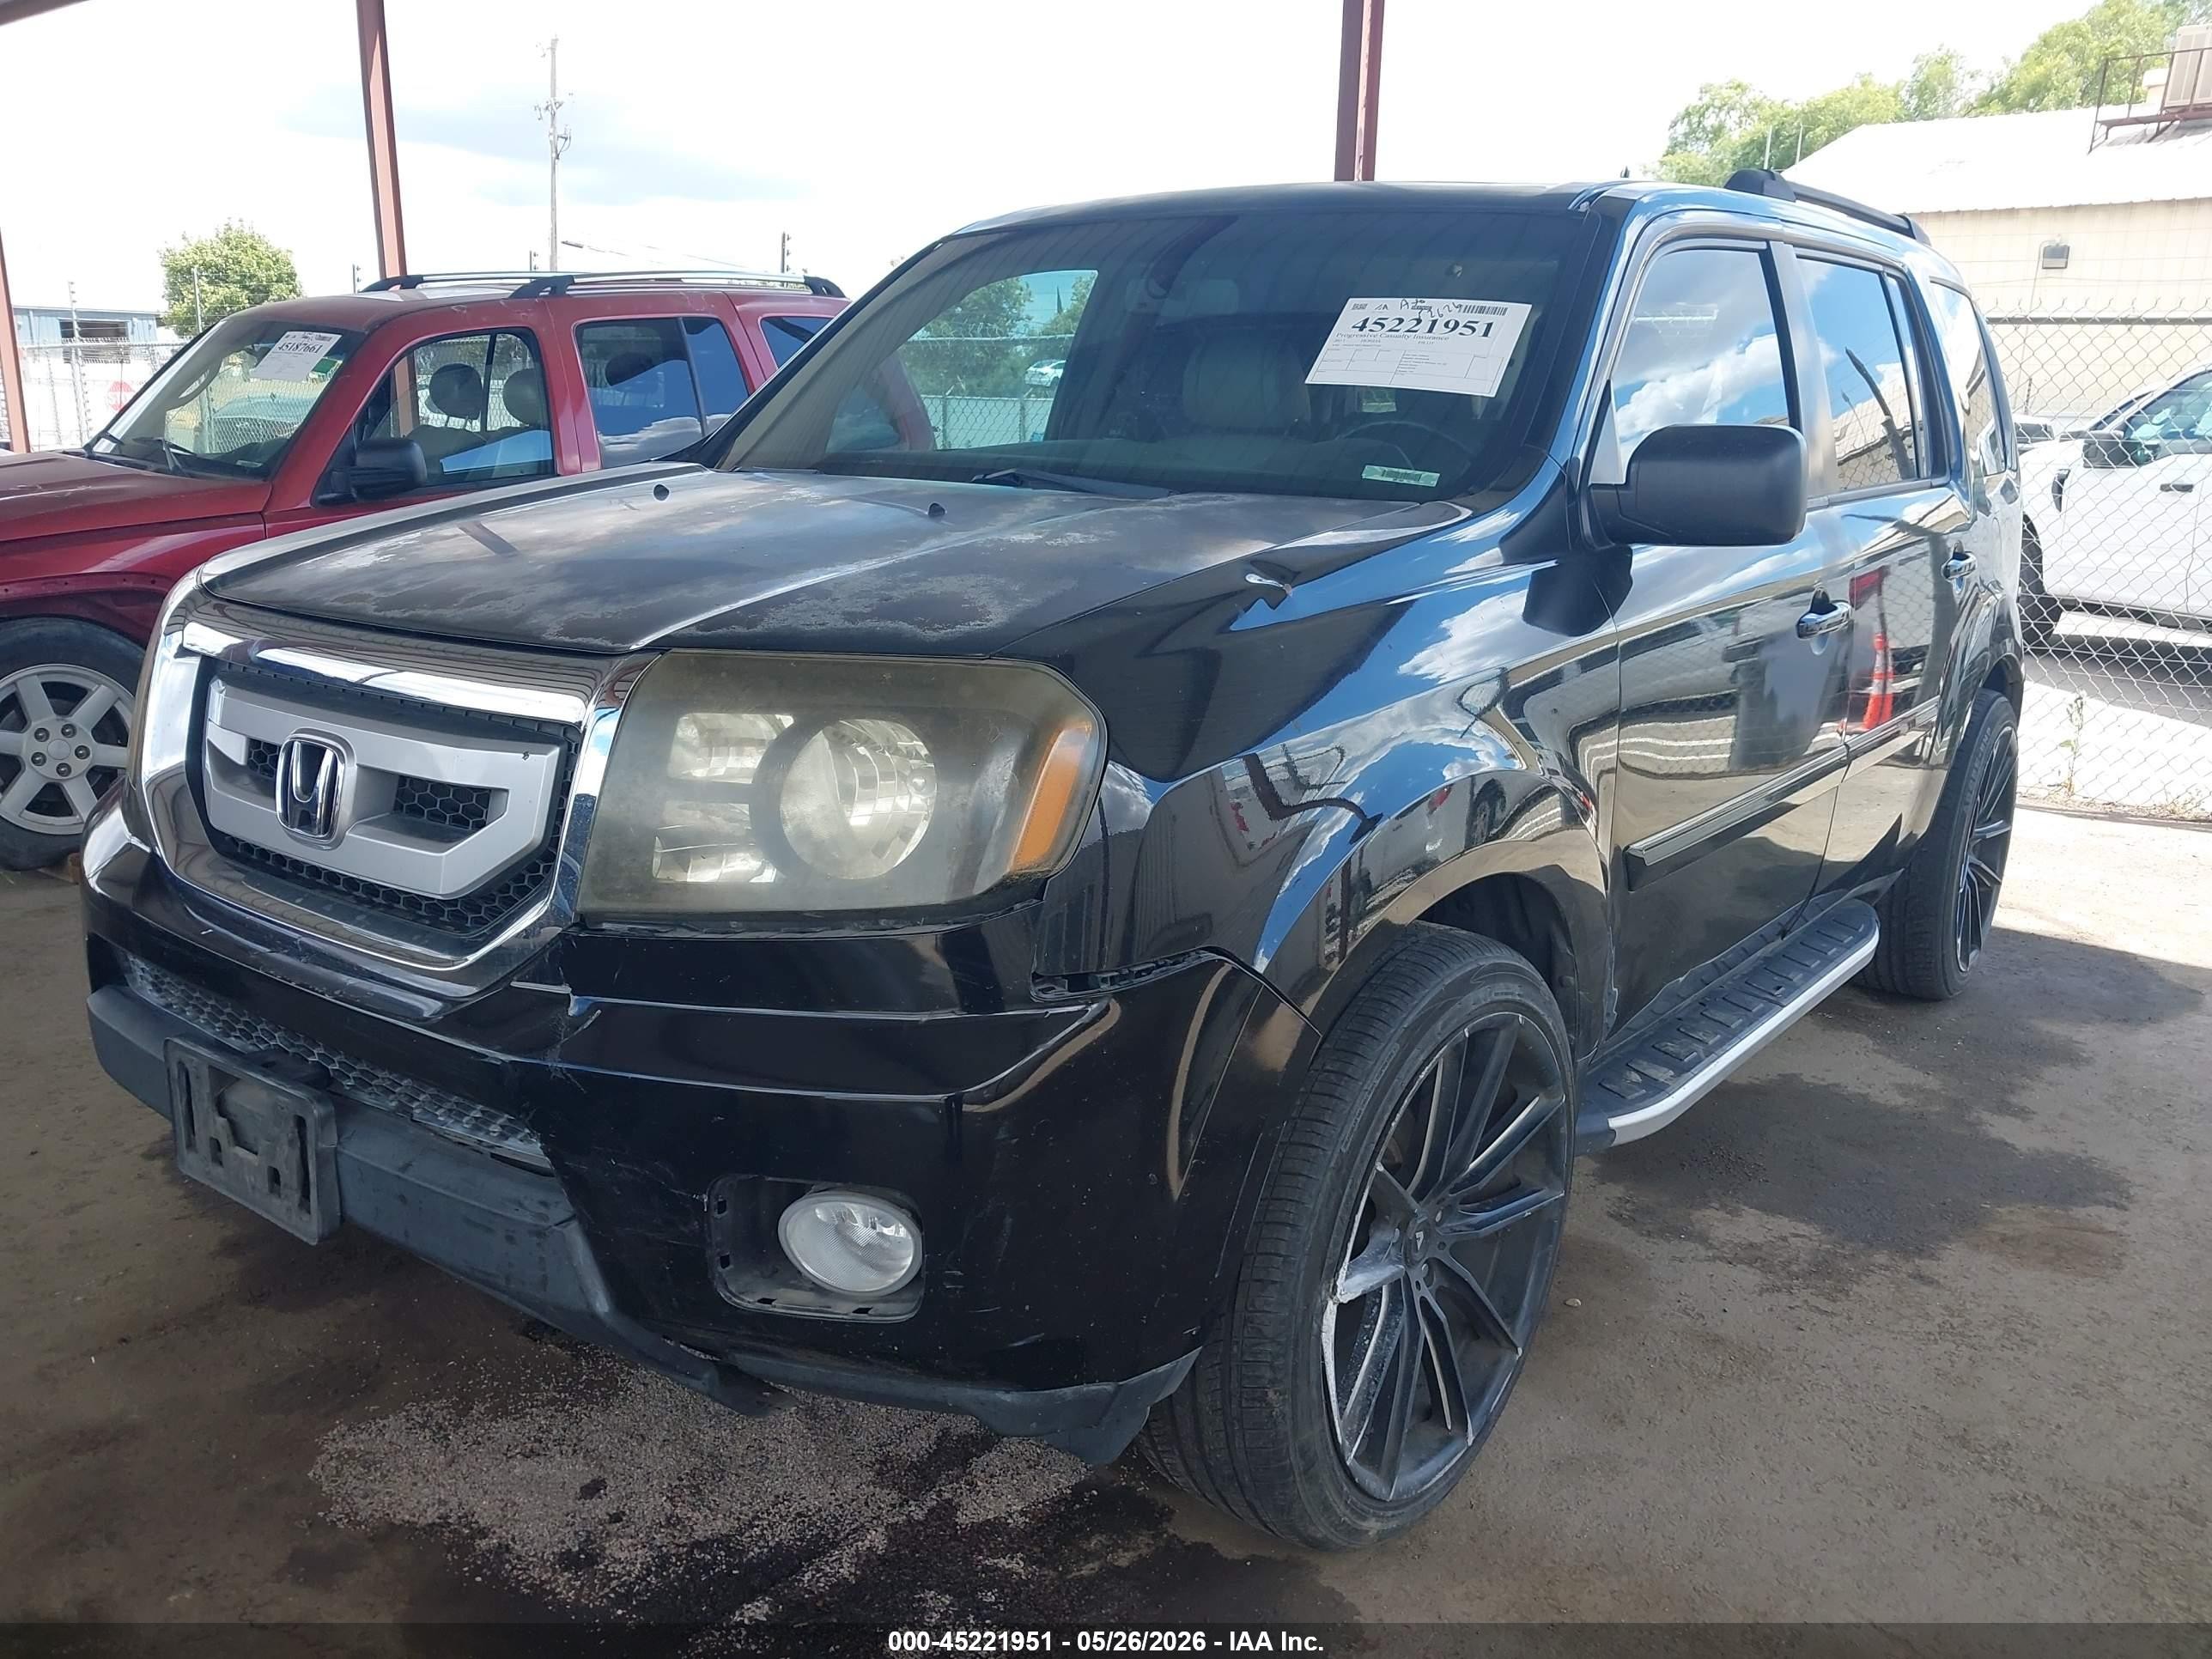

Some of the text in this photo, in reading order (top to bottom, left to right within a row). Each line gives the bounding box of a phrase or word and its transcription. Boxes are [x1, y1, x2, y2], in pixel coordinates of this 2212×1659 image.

[1352, 316, 1494, 338] 45221951
[1379, 332, 1412, 341] Casualty
[278, 343, 324, 353] 45187661
